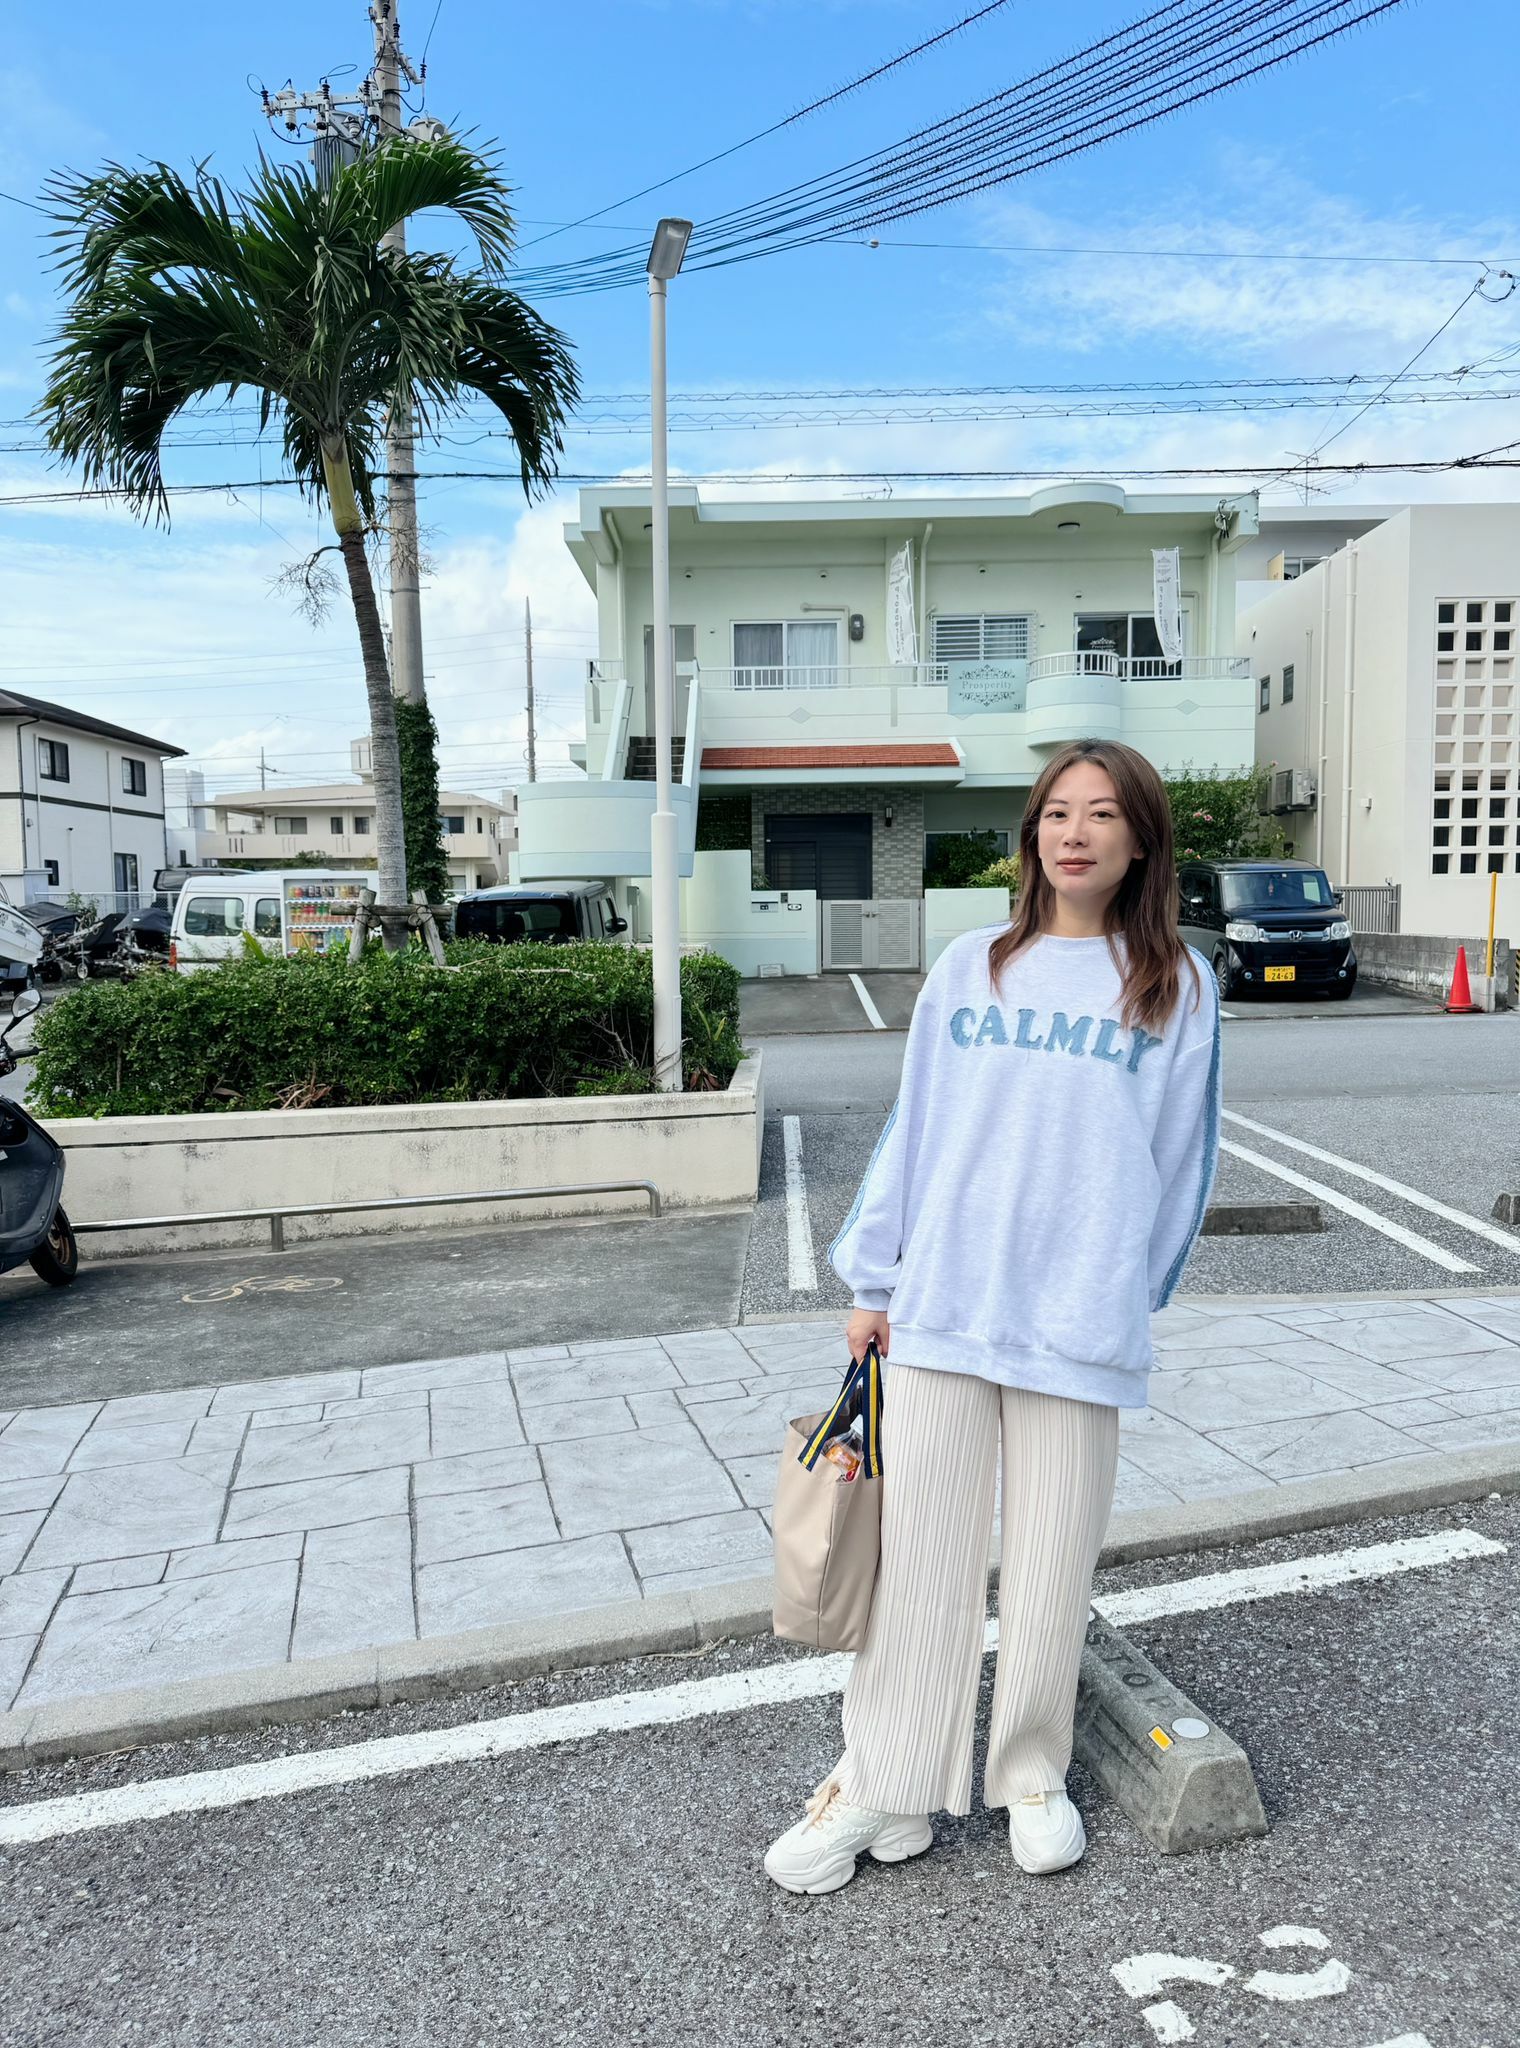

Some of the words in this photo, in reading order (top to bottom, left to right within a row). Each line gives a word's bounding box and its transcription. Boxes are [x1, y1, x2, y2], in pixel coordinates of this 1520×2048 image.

[962, 680, 1012, 690] Prosperity
[950, 1005, 1163, 1074] CALMLY
[1085, 1633, 1176, 1708] STOP
